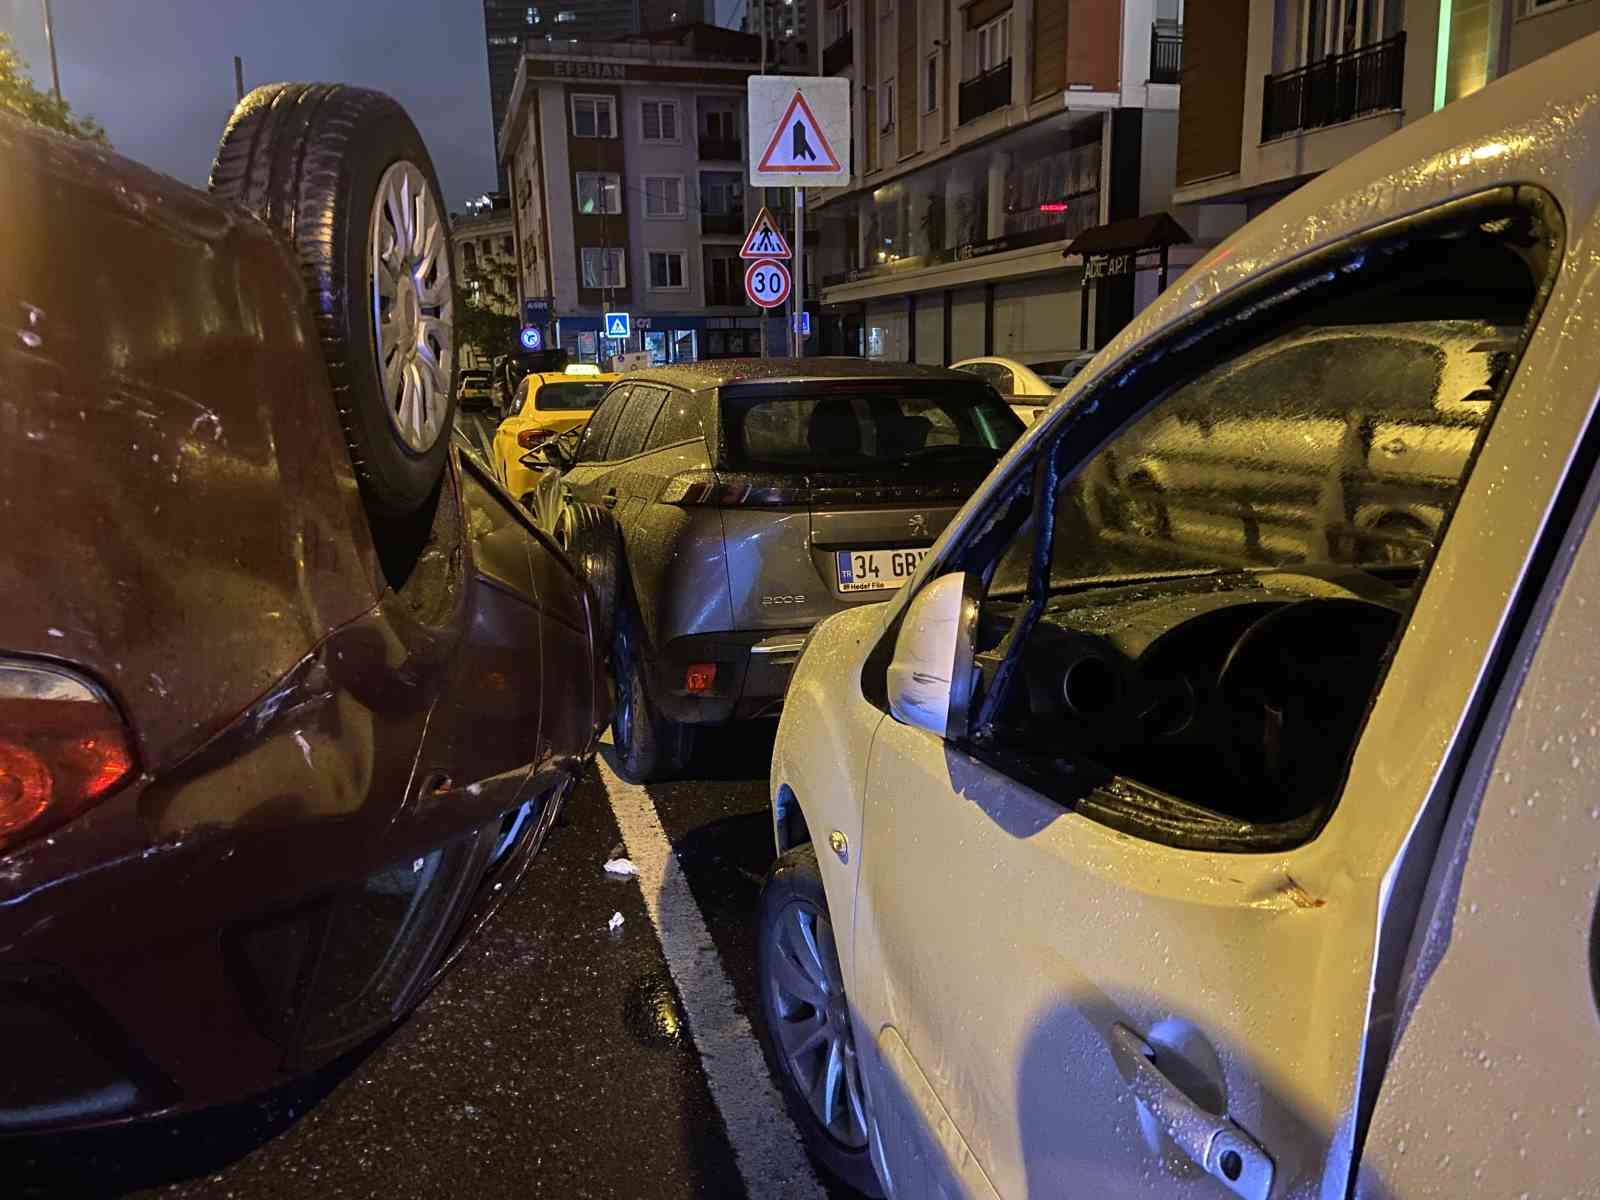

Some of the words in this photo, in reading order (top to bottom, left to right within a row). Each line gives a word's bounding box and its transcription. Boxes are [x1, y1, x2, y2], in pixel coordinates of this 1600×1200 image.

[754, 272, 781, 293] 30
[840, 570, 852, 578] TR
[854, 554, 880, 579] 34
